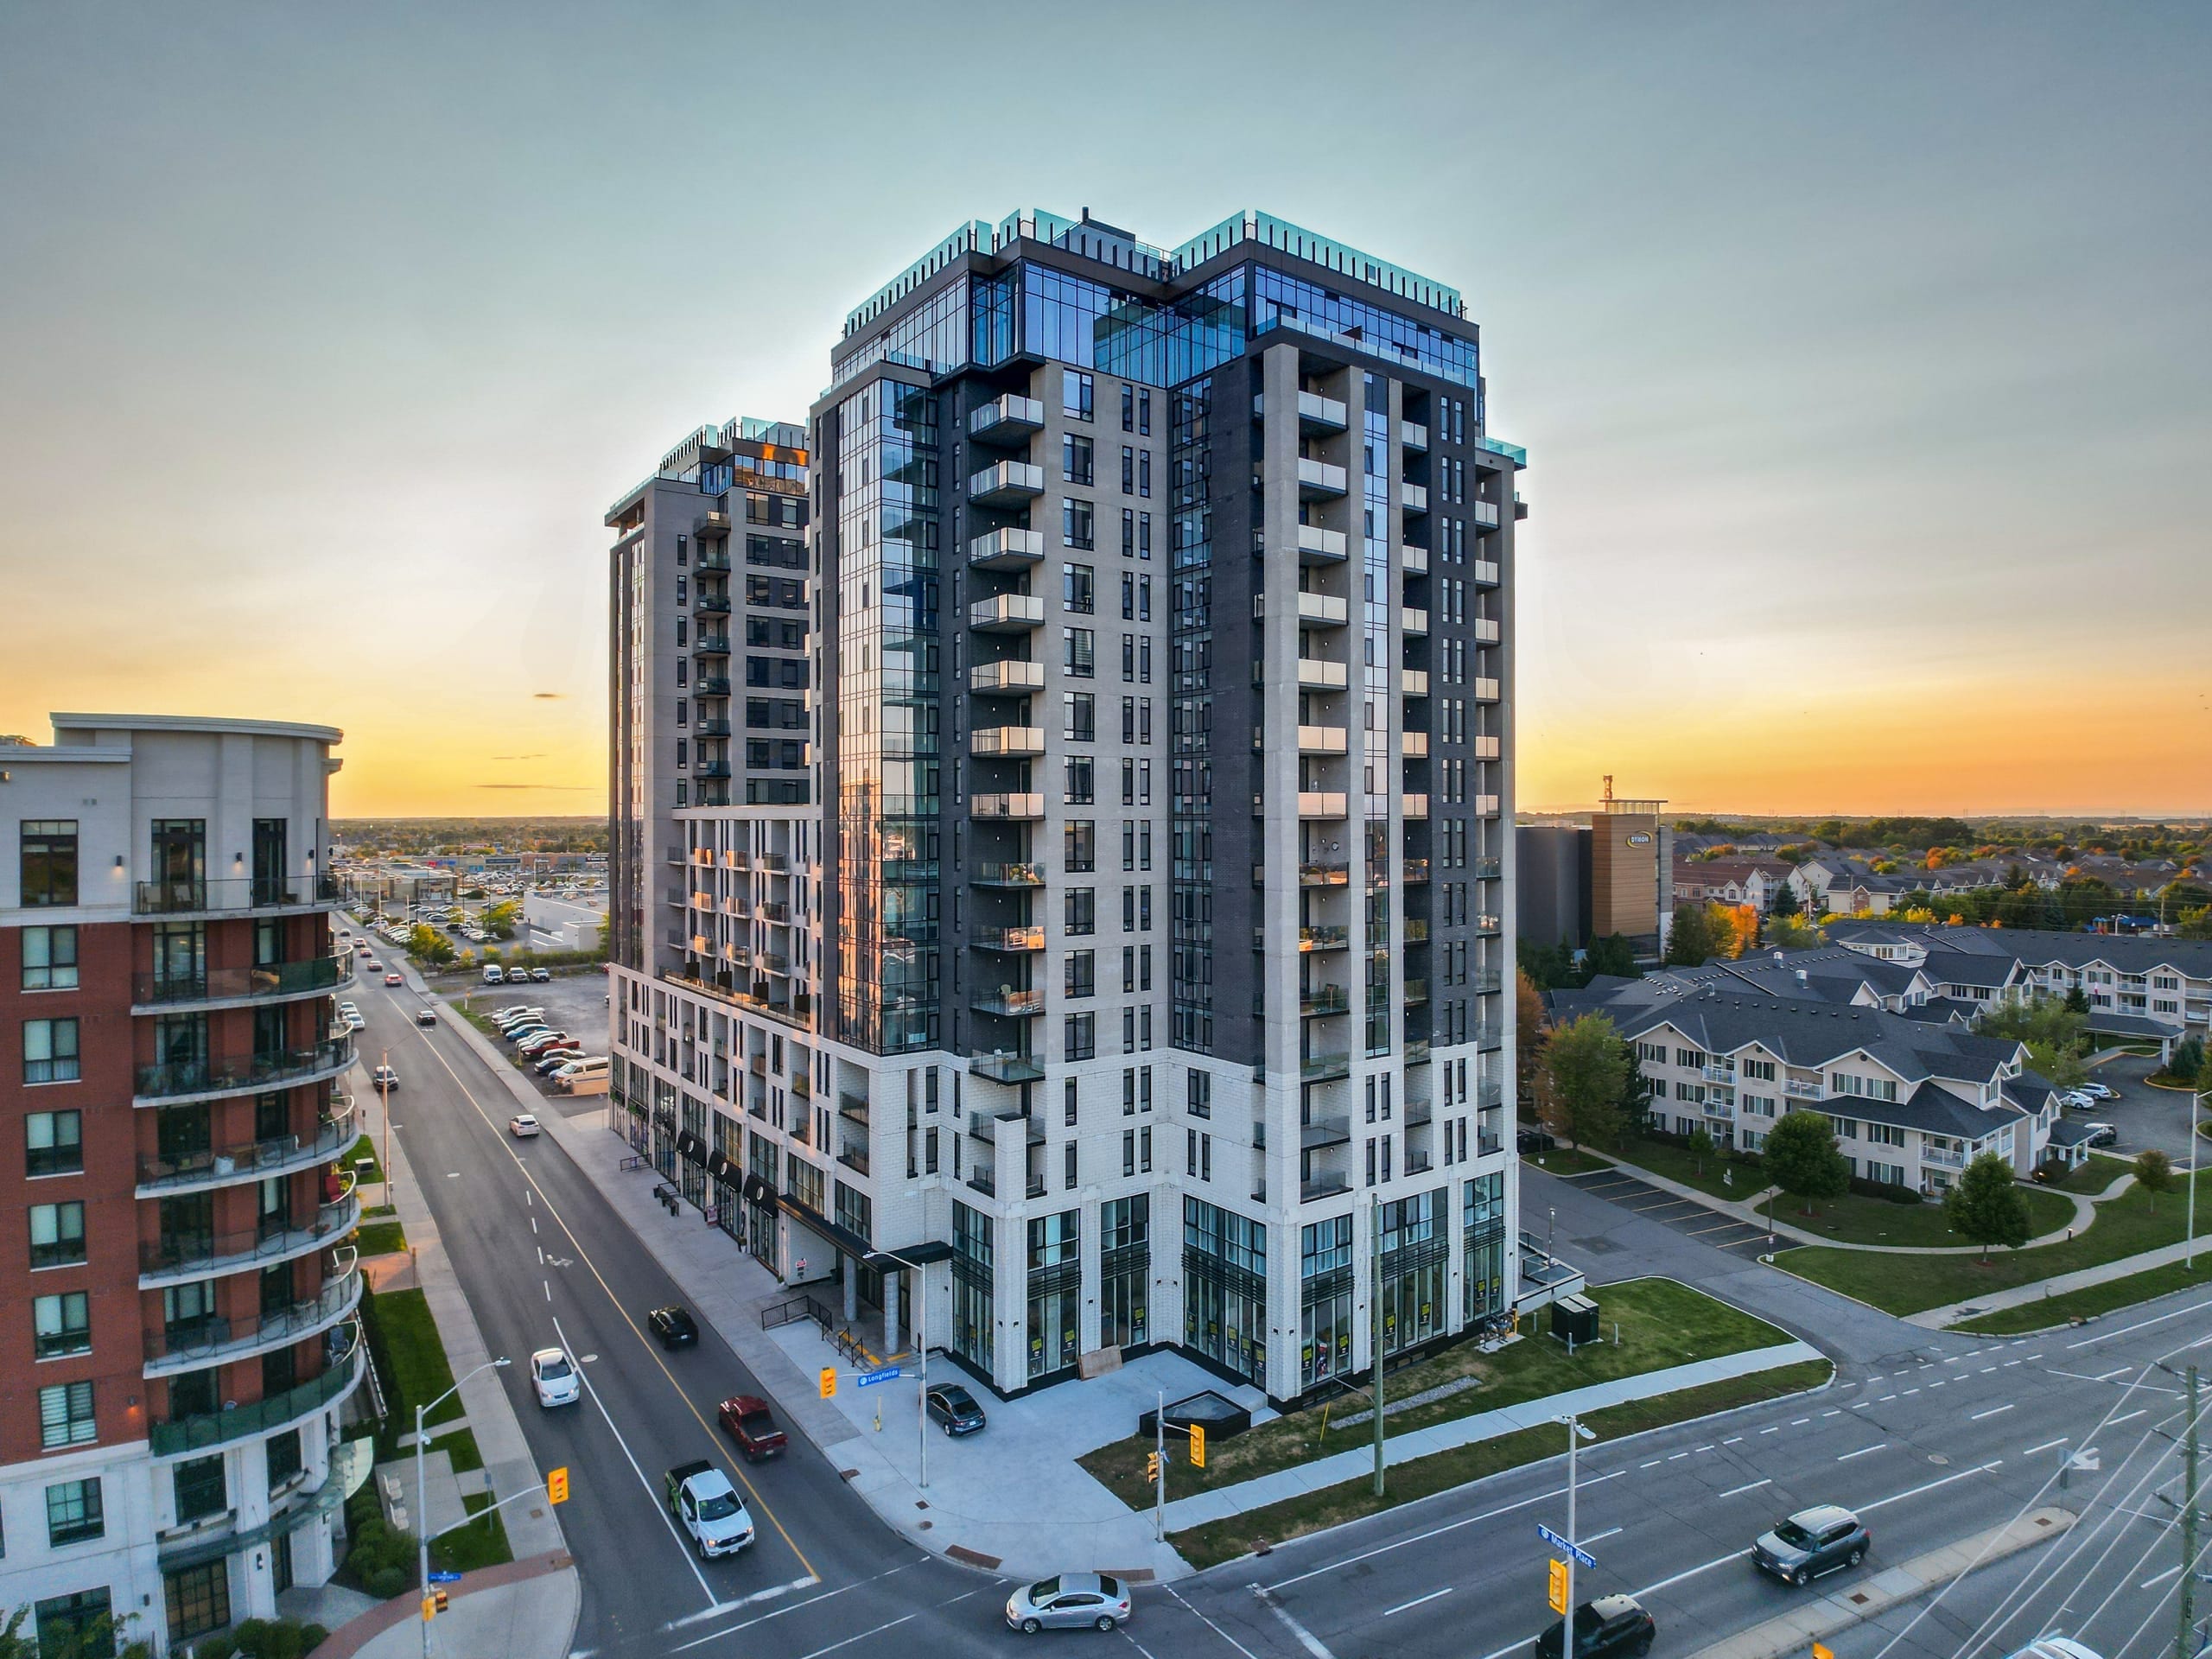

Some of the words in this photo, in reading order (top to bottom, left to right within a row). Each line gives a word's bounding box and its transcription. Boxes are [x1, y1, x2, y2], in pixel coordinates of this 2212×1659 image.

[868, 1369, 899, 1382] Longfields
[1551, 1534, 1573, 1556] Market
[1575, 1549, 1592, 1568] Place
